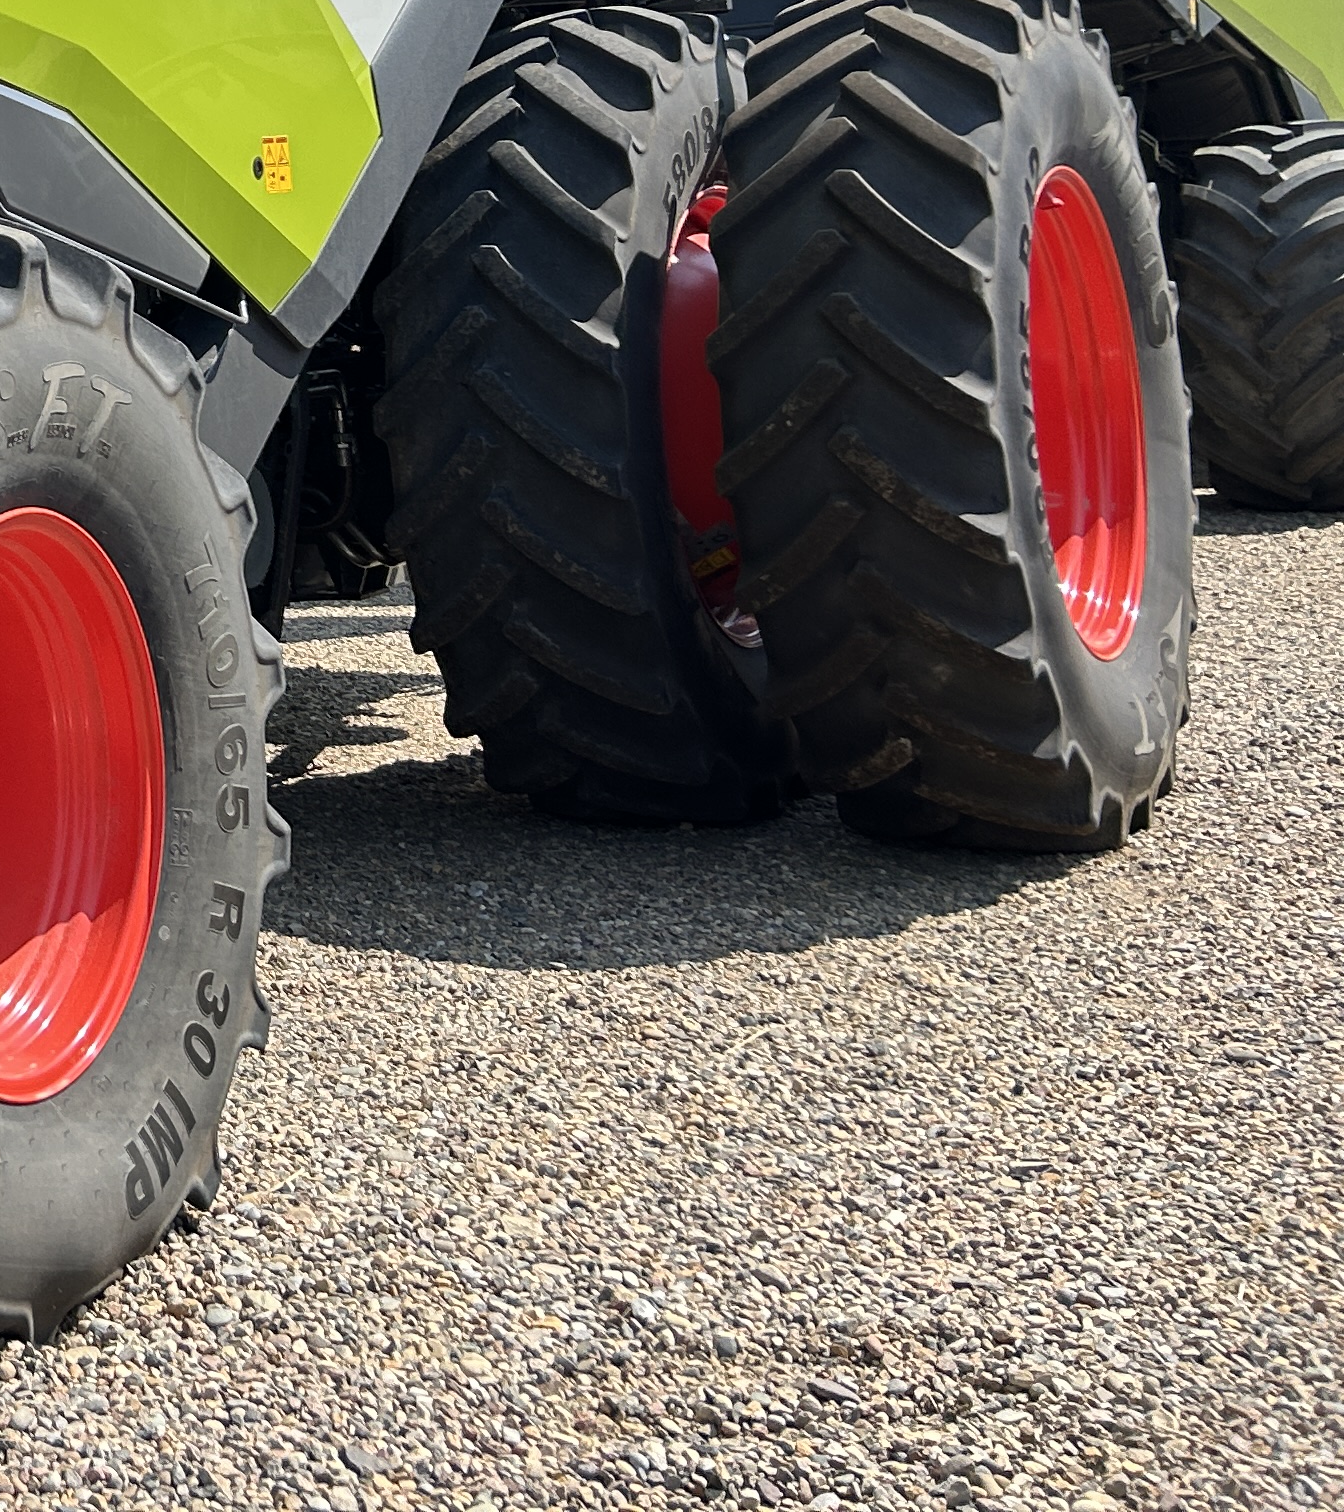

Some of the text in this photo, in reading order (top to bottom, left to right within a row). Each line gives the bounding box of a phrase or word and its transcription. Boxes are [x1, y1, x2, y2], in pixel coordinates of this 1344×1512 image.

[123, 532, 251, 1223] 710/65 R 30 IMP
